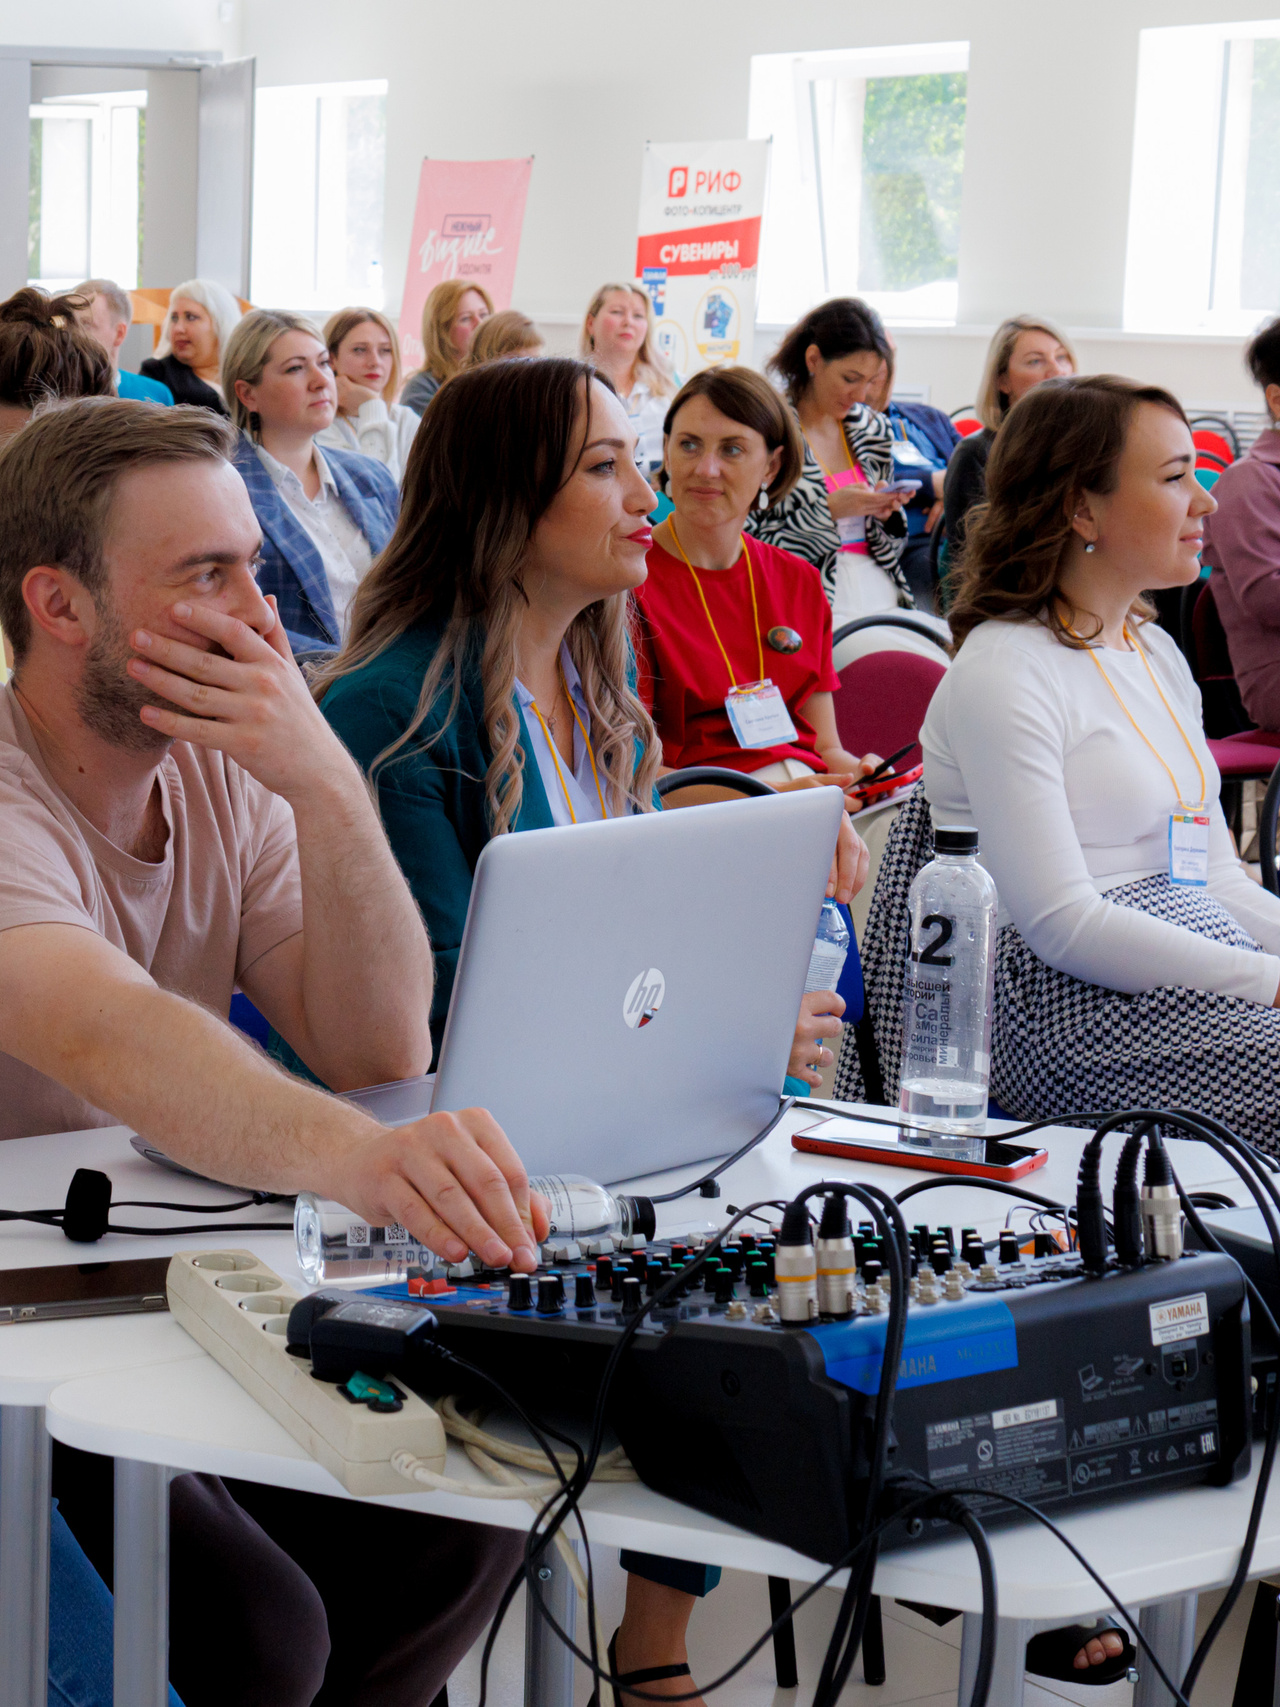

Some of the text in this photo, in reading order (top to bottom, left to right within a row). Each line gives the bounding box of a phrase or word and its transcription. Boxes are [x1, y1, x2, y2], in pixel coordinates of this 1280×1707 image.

[695, 169, 741, 194] РИФ
[660, 240, 739, 264] СУВЕНИРЫ
[721, 262, 740, 280] 100
[915, 1003, 938, 1022] Ca
[911, 1033, 937, 1045] сила
[939, 993, 951, 1065] минералы
[1167, 1301, 1202, 1321] YAMAHA
